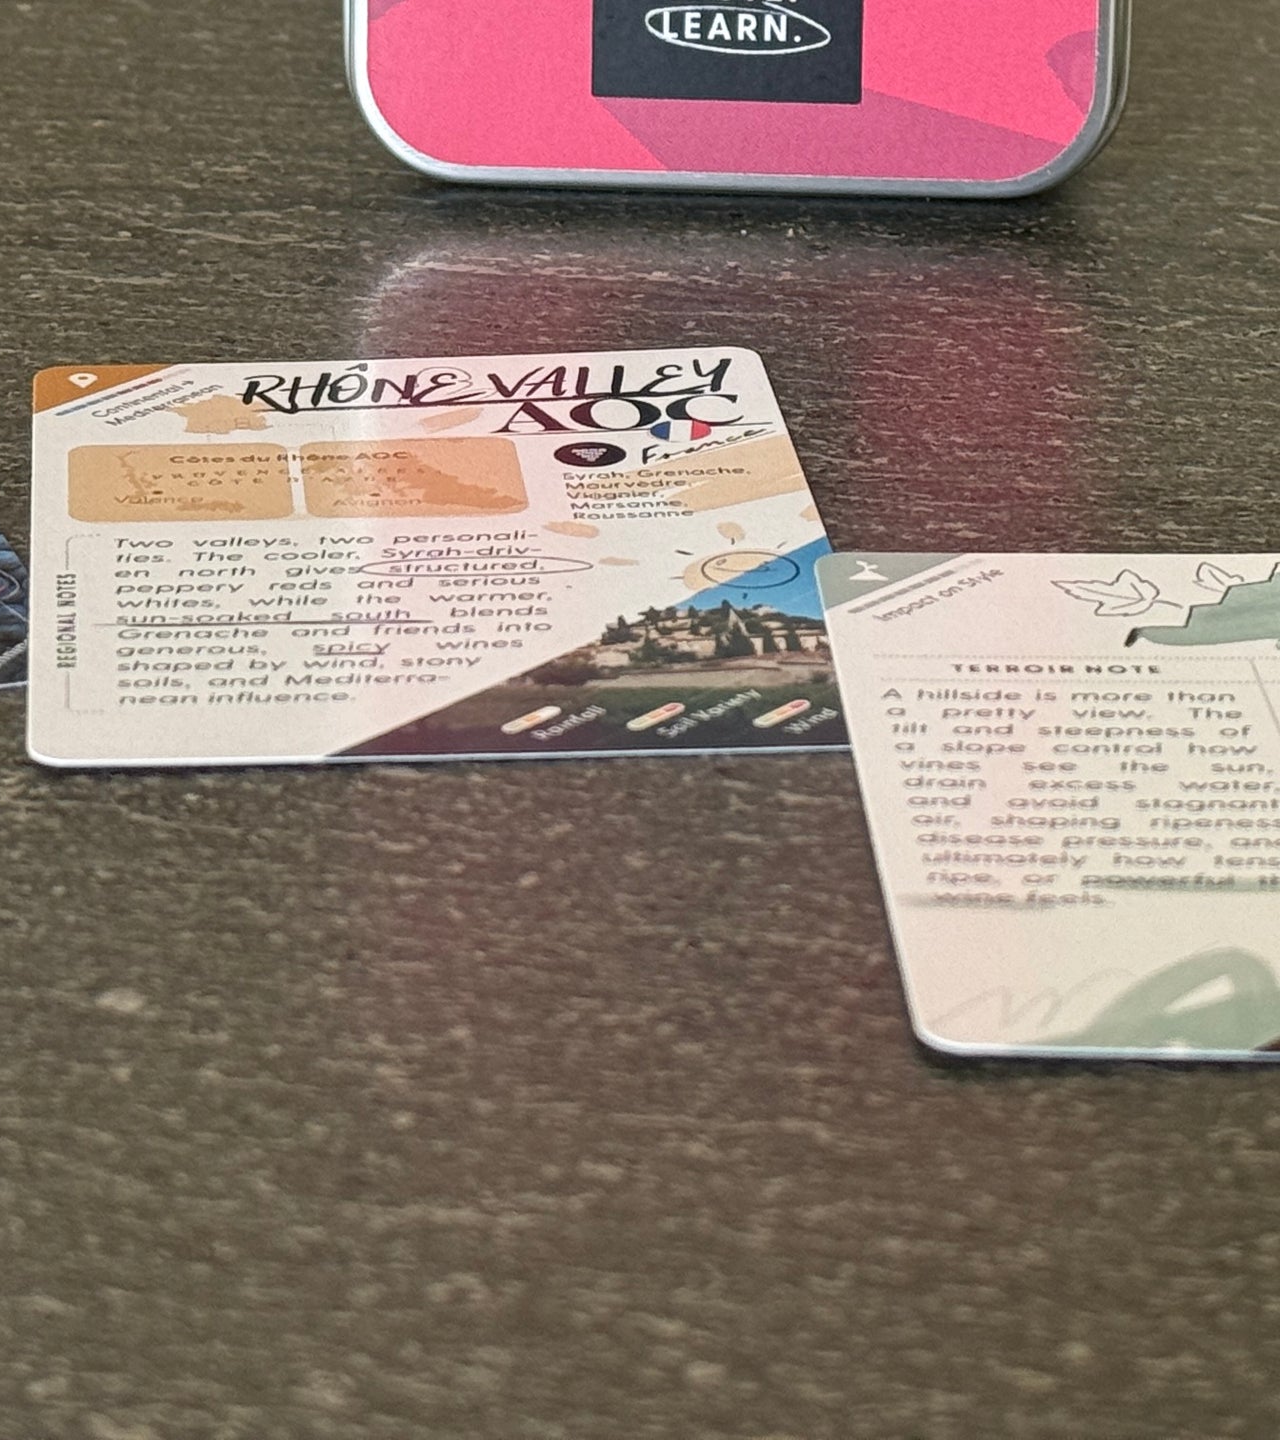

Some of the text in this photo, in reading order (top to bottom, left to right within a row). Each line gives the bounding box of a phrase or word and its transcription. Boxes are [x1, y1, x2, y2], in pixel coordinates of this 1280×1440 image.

[663, 11, 801, 42] LEARN.
[235, 358, 732, 413] RHÔNE VALLEY
[491, 394, 744, 432] AOC
[642, 428, 767, 464] France
[355, 452, 408, 460] AOC
[573, 510, 694, 519] Roussanne
[115, 539, 173, 548] Two
[320, 536, 373, 544] two
[393, 531, 538, 544] personali-
[117, 553, 171, 563] ties.
[193, 552, 243, 561] The
[382, 547, 542, 559] Syrah-driv-
[115, 570, 150, 578] en
[178, 567, 256, 576] north
[285, 565, 361, 578] gives
[116, 575, 540, 594] peppery reds and serious
[249, 595, 328, 607] while
[357, 595, 401, 604] the
[872, 568, 1004, 622] Impact on Style
[56, 574, 77, 668] REGIONAL NOTES
[117, 605, 547, 623] sun-soaked south blends
[117, 622, 552, 639] Grenache and friends into
[313, 641, 391, 654] spicy
[436, 639, 523, 650] wines
[117, 660, 234, 672] shaped
[249, 659, 287, 671] by
[401, 657, 481, 667] stony
[951, 664, 1161, 674] TERROIR NOTE
[208, 675, 268, 687] and
[284, 674, 450, 685] Mediterra-
[120, 691, 355, 704] nean influence.
[881, 688, 1236, 702] A hillside is more than
[887, 707, 906, 716] a
[942, 707, 1037, 720] pretty
[1189, 707, 1243, 719] The
[892, 722, 1252, 738] tilt and steepness of
[895, 740, 1257, 755] a slope control how
[900, 759, 980, 770] vines
[1022, 761, 1077, 772] see
[1120, 761, 1169, 772] the
[904, 775, 986, 789] drain
[1028, 779, 1137, 791] excess
[908, 794, 1279, 811] and avoid stagnant
